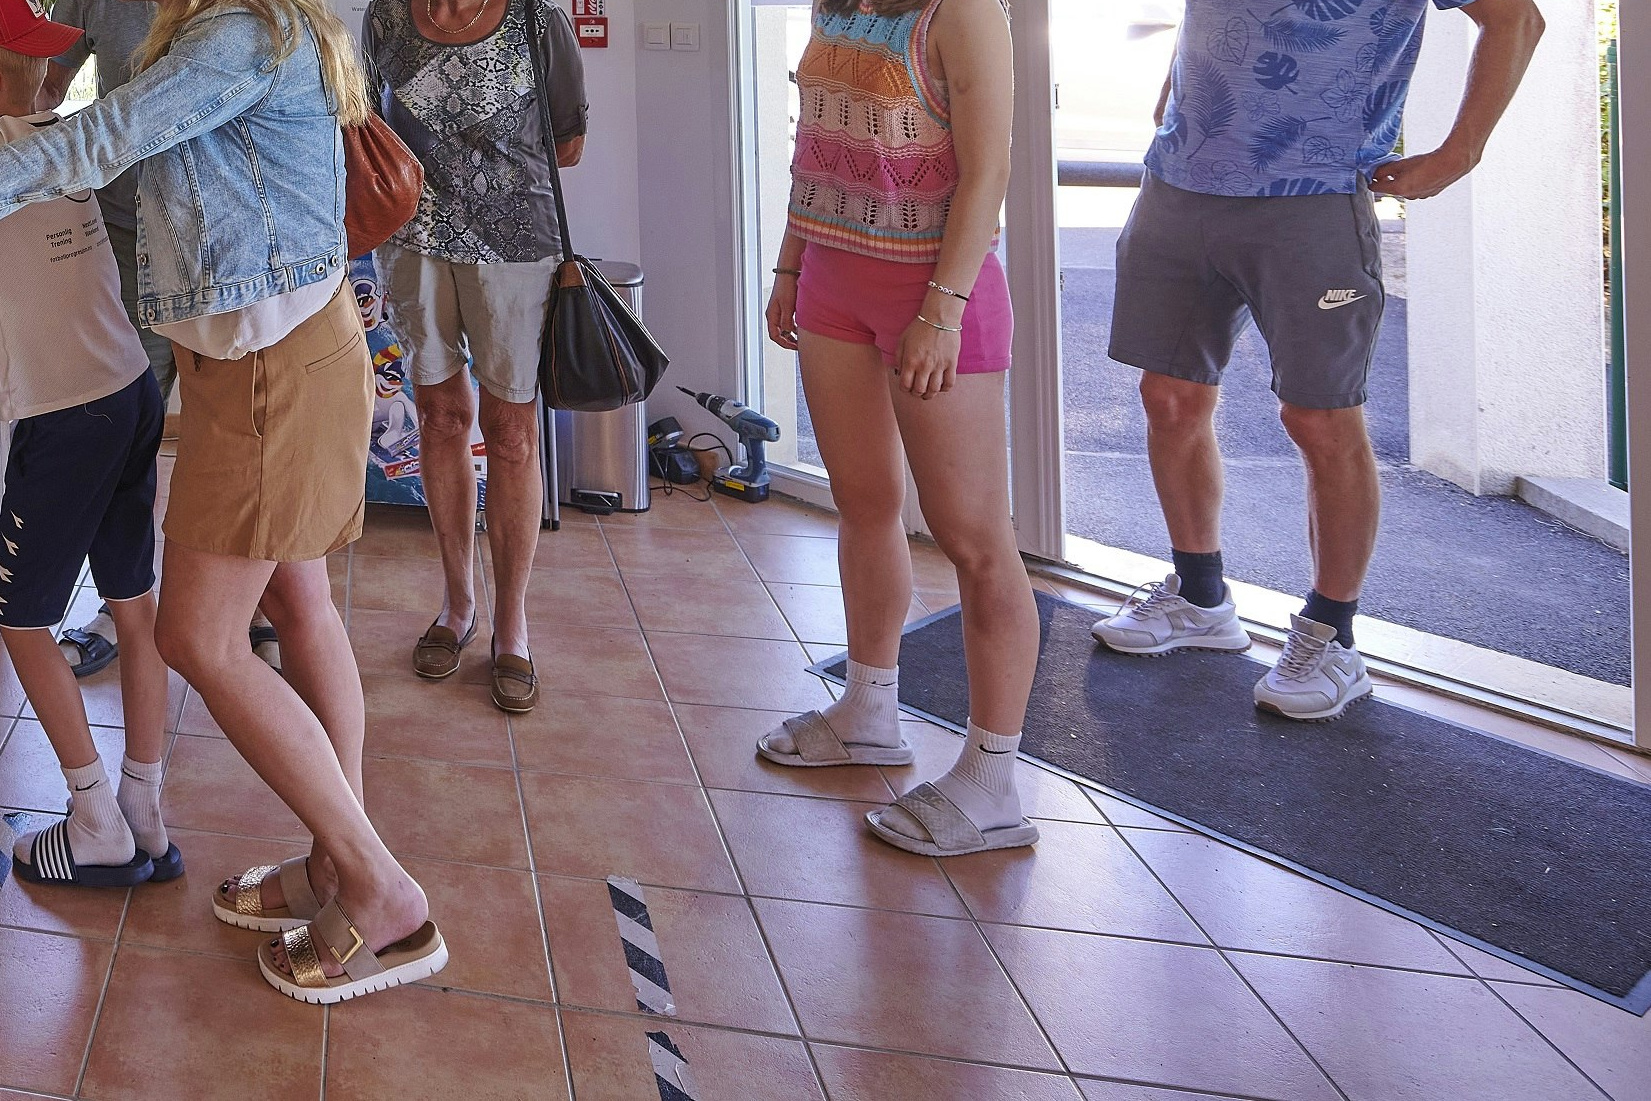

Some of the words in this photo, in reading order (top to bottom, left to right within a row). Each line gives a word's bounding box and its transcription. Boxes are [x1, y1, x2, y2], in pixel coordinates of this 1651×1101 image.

[46, 228, 72, 240] Personlig
[51, 238, 72, 248] Trening
[1325, 289, 1356, 301] NIKE
